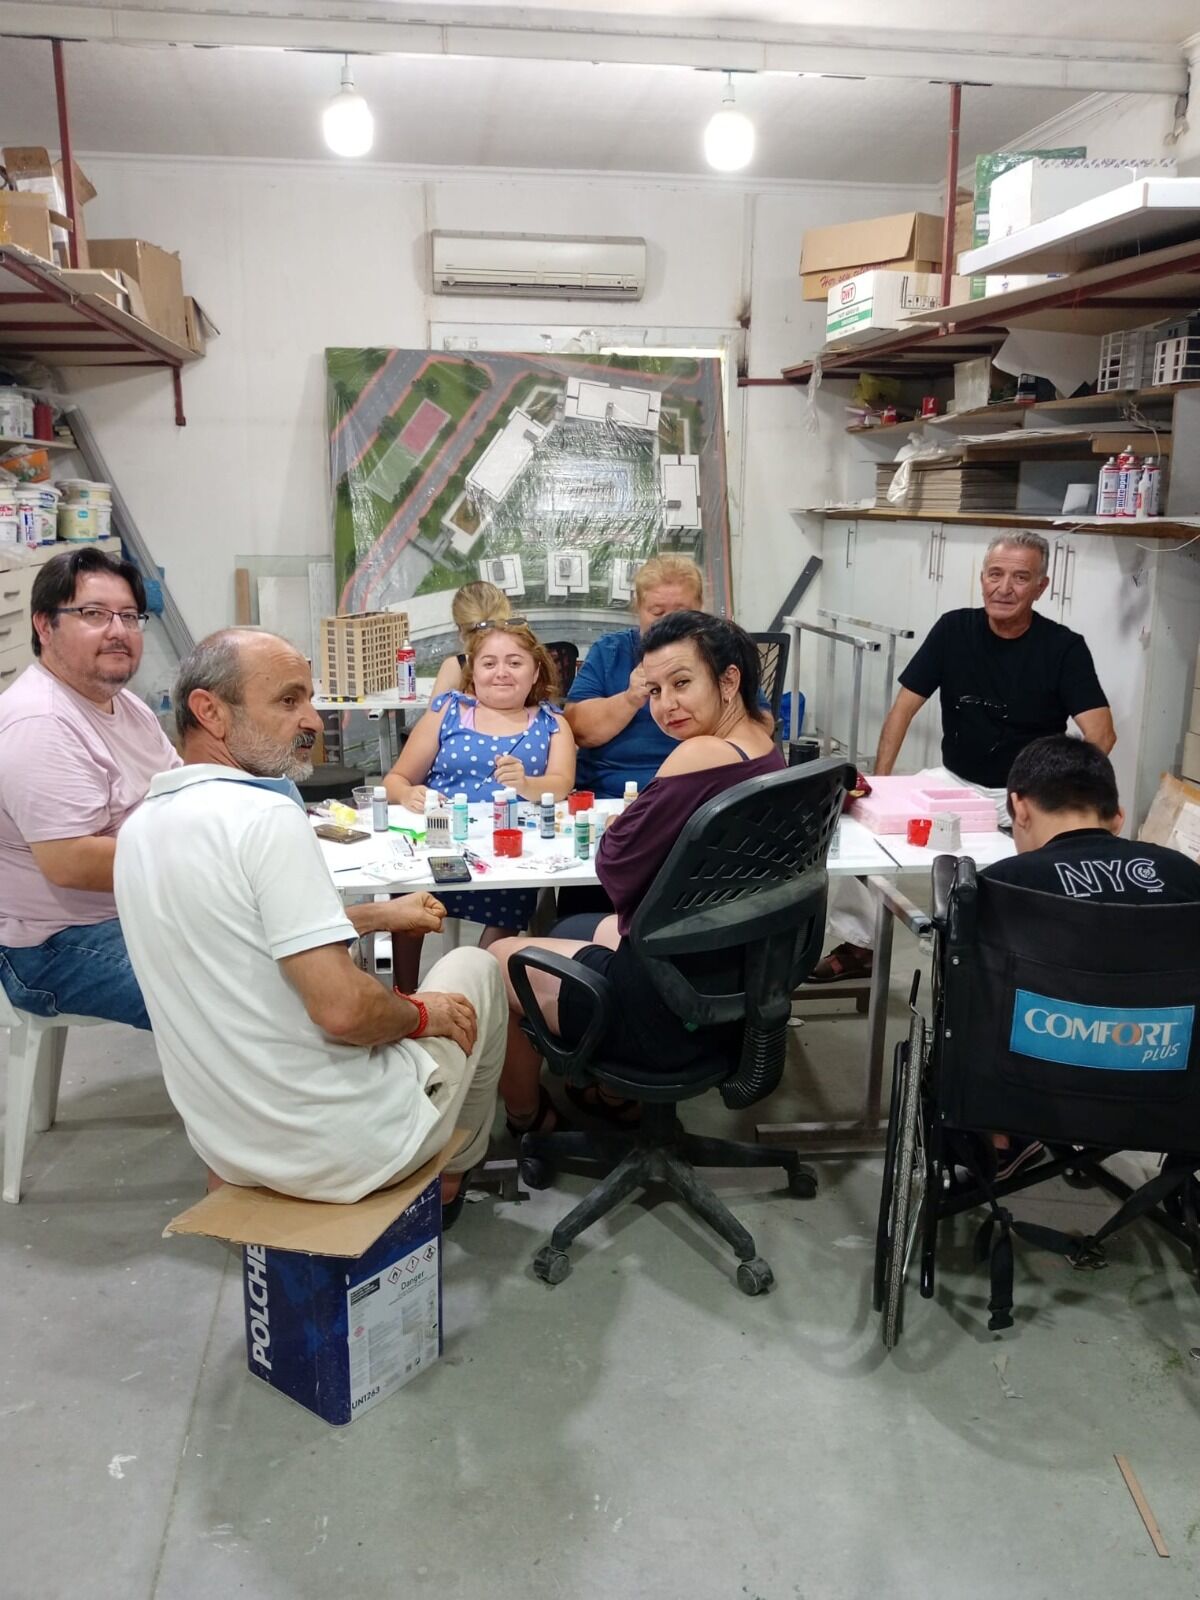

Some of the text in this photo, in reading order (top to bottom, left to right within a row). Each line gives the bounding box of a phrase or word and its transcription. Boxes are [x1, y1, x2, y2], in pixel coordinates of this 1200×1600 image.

[1054, 858, 1165, 895] NYC
[1024, 1008, 1182, 1046] COMFORT
[1141, 1043, 1181, 1064] PLUS
[401, 1271, 425, 1290] Danger
[351, 1386, 380, 1410] UN1263
